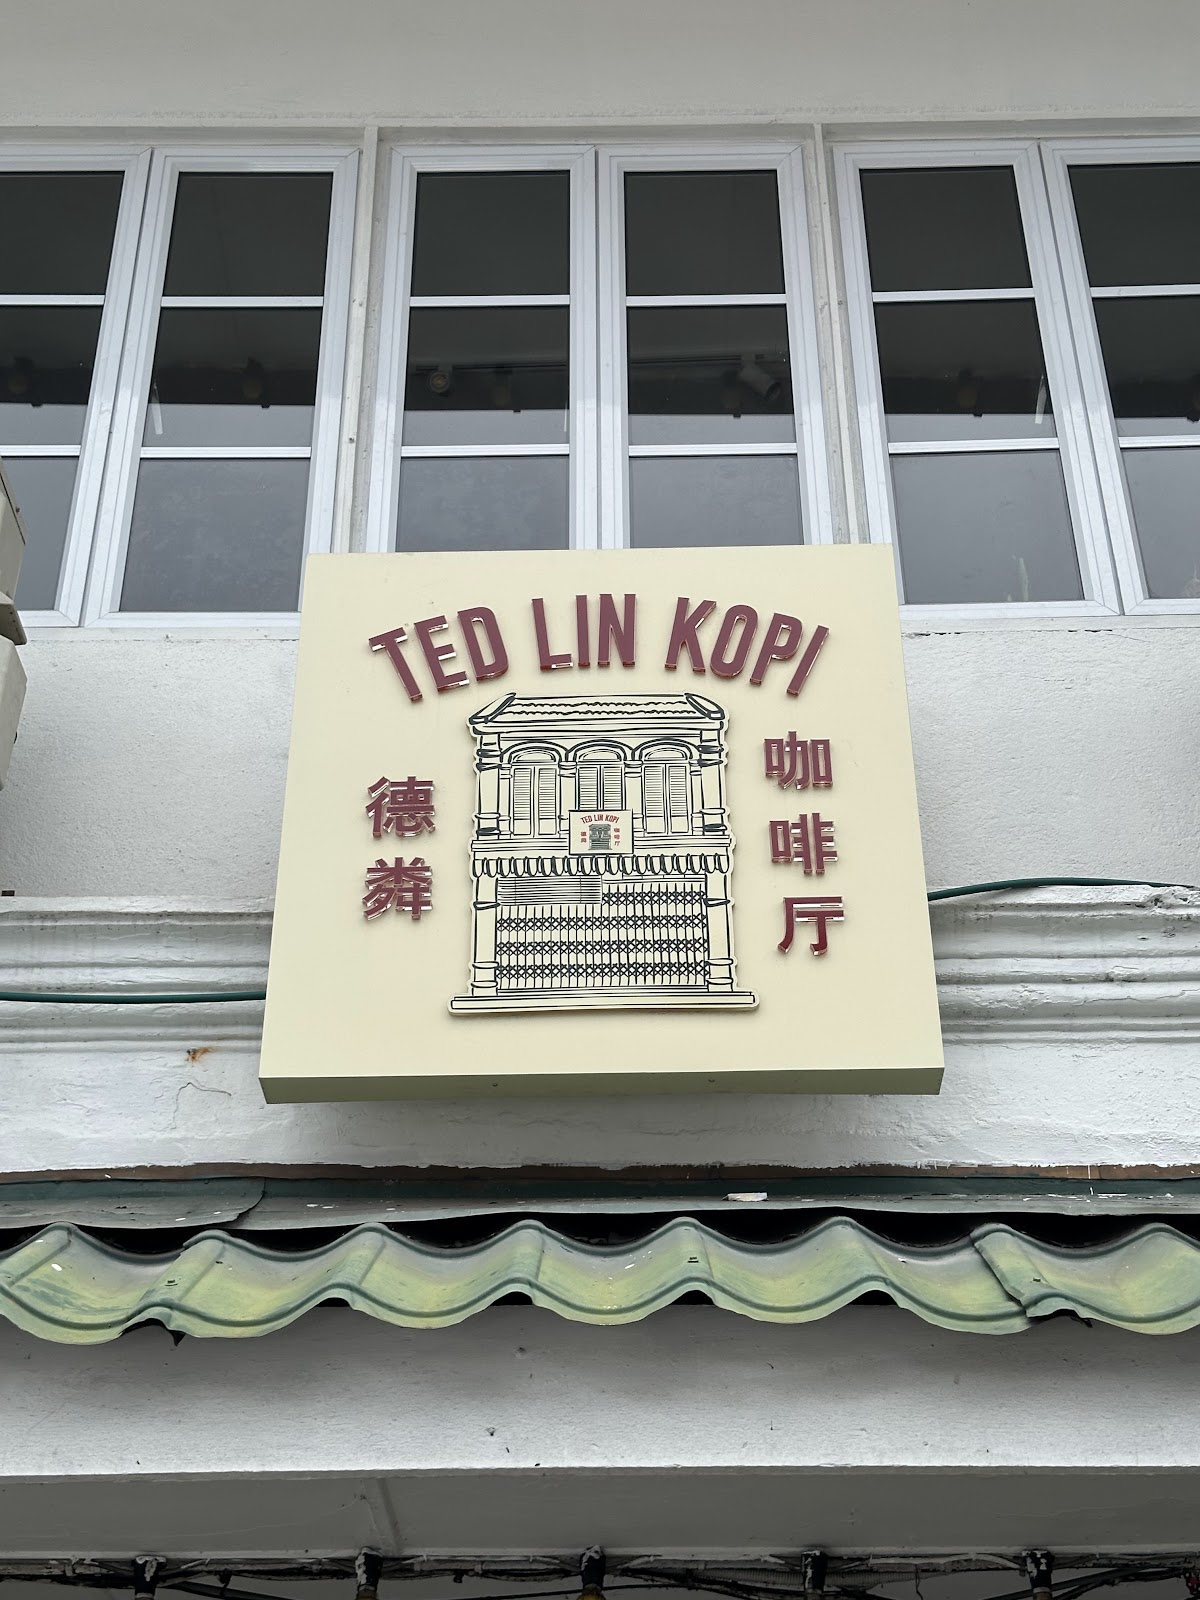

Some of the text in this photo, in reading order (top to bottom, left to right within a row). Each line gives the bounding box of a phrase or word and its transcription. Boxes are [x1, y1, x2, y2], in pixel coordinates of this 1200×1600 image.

[369, 593, 829, 702] TED LIN KOPI
[764, 731, 845, 956] 咖啡厅
